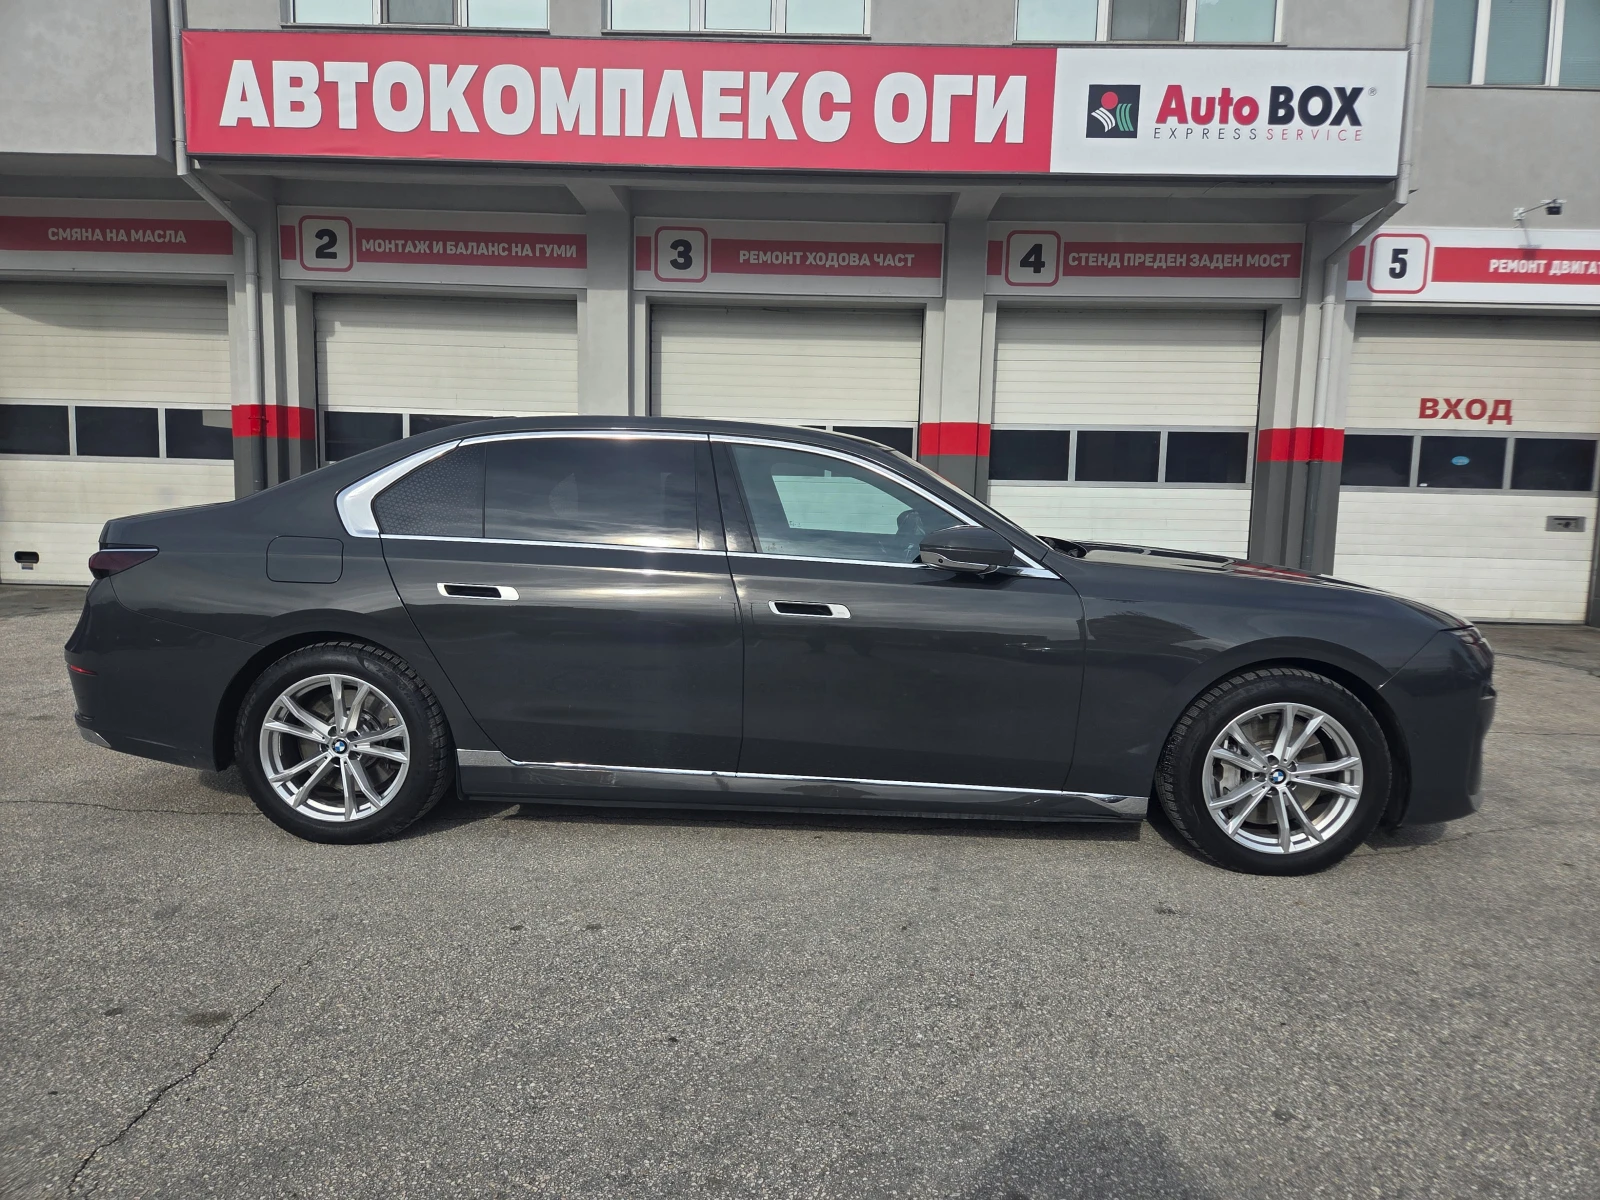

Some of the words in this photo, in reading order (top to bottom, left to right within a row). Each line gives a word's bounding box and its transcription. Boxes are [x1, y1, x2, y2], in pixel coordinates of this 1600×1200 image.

[219, 59, 852, 143] АВТОКОМПЛЕКС
[873, 72, 1027, 144] ОГИ
[1155, 84, 1260, 126] Auto
[1153, 127, 1258, 140] EXPRESS
[1266, 128, 1363, 142] SERVICE
[47, 227, 104, 242] СМЯНА
[105, 228, 129, 243] НА
[130, 229, 187, 244] МАСЛА
[314, 228, 338, 260] 2
[361, 238, 431, 254] МОНТАЖ
[432, 240, 444, 254] И
[446, 241, 509, 257] БАЛАНС
[511, 243, 534, 257] НА
[535, 243, 577, 258] ГУМИ
[669, 238, 693, 271] 3
[739, 250, 804, 266] РЕМОНТ
[805, 251, 871, 268] ХОДОВА
[873, 253, 915, 267] ЧАСТ
[1019, 243, 1046, 274] 4
[1068, 252, 1121, 269] СТЕНД
[1123, 253, 1187, 270] ПРЕДЕН
[1189, 253, 1244, 270] ЗАДЕН
[1246, 254, 1292, 268] МОСТ
[1388, 248, 1409, 280] 5
[1488, 258, 1548, 274] РЕМОНТ
[1548, 259, 1600, 276] ДВИГА
[1418, 397, 1513, 425] ВХОД
